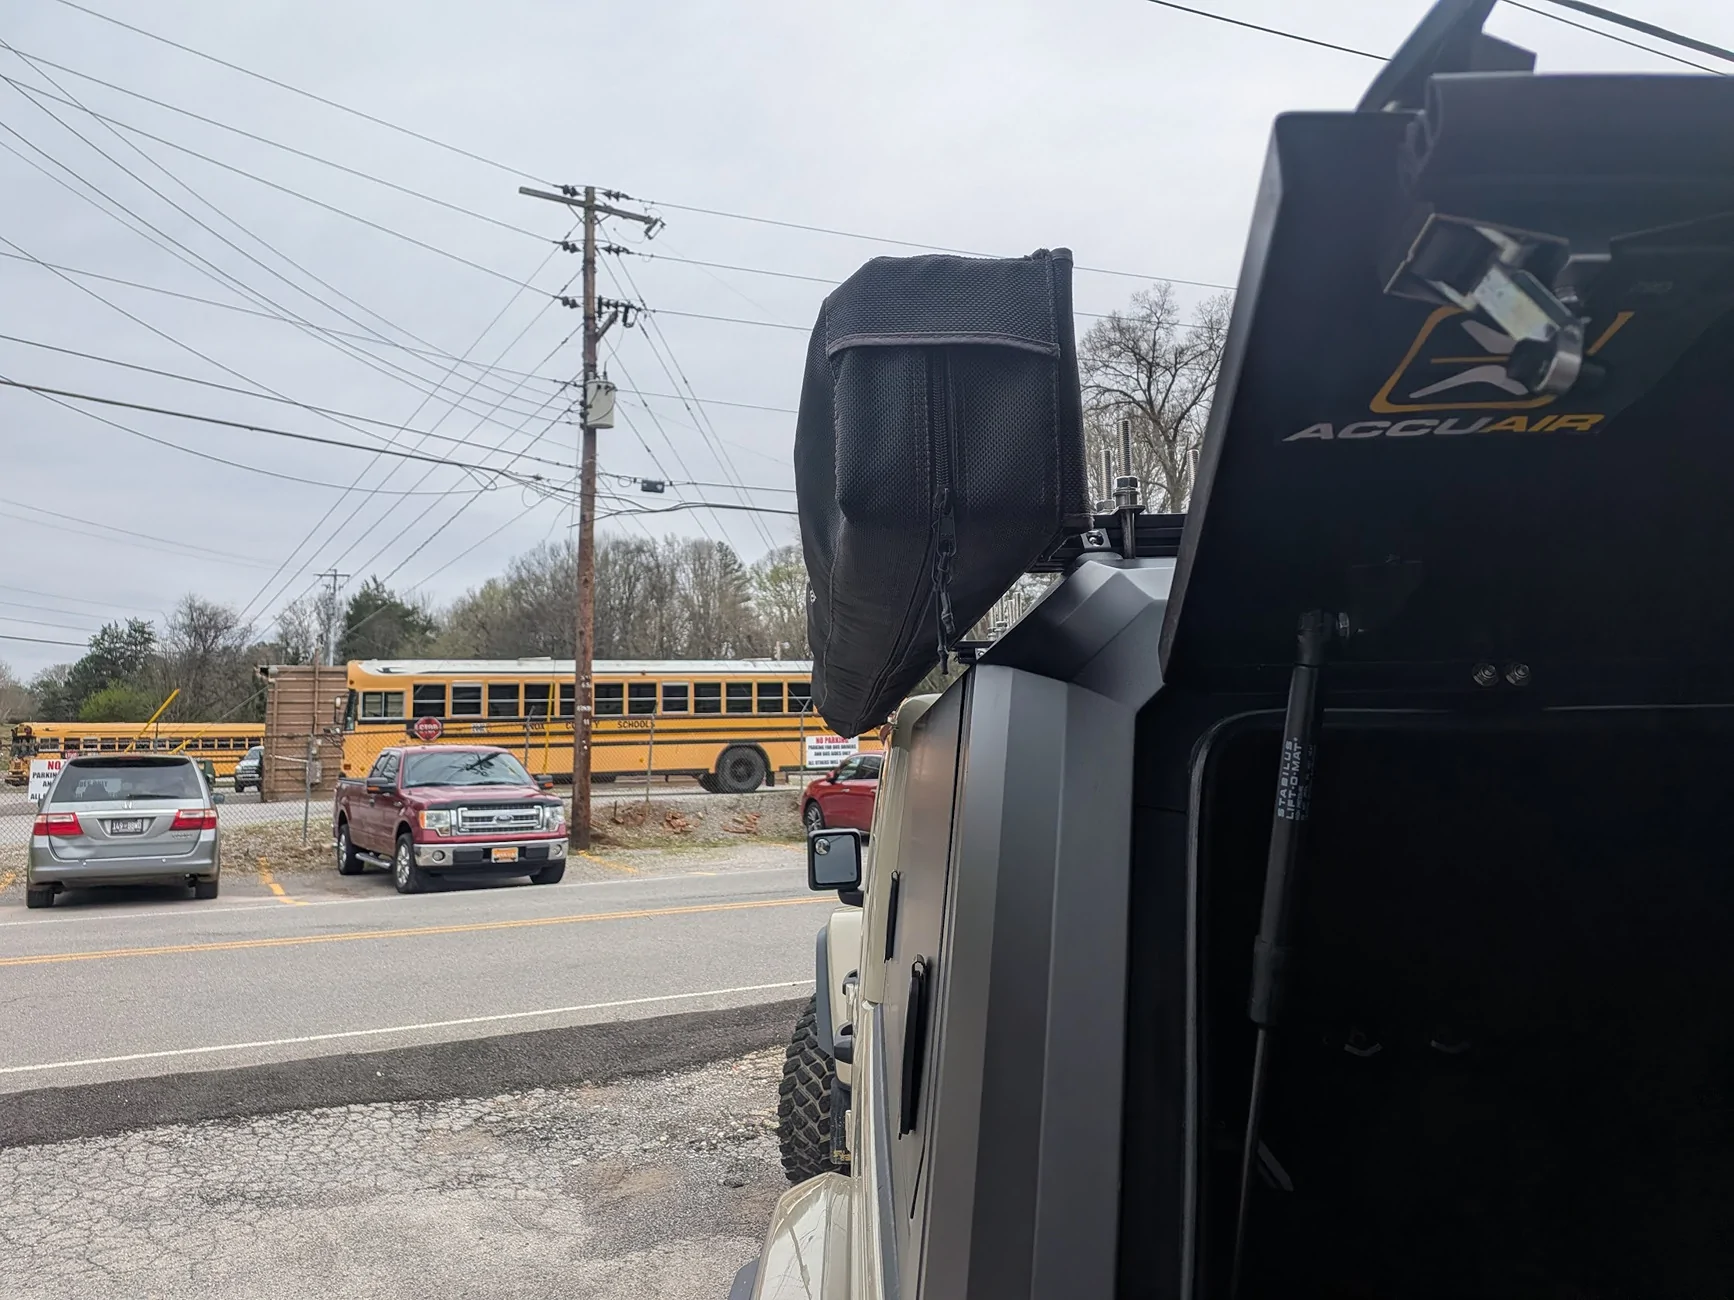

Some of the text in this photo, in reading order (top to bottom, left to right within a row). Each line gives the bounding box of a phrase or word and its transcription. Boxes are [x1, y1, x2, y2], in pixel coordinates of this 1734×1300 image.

[1282, 413, 1605, 441] ACCUAIR
[617, 720, 656, 729] SCHOOLS
[47, 760, 61, 770] NO
[1277, 740, 1293, 818] STABILUS
